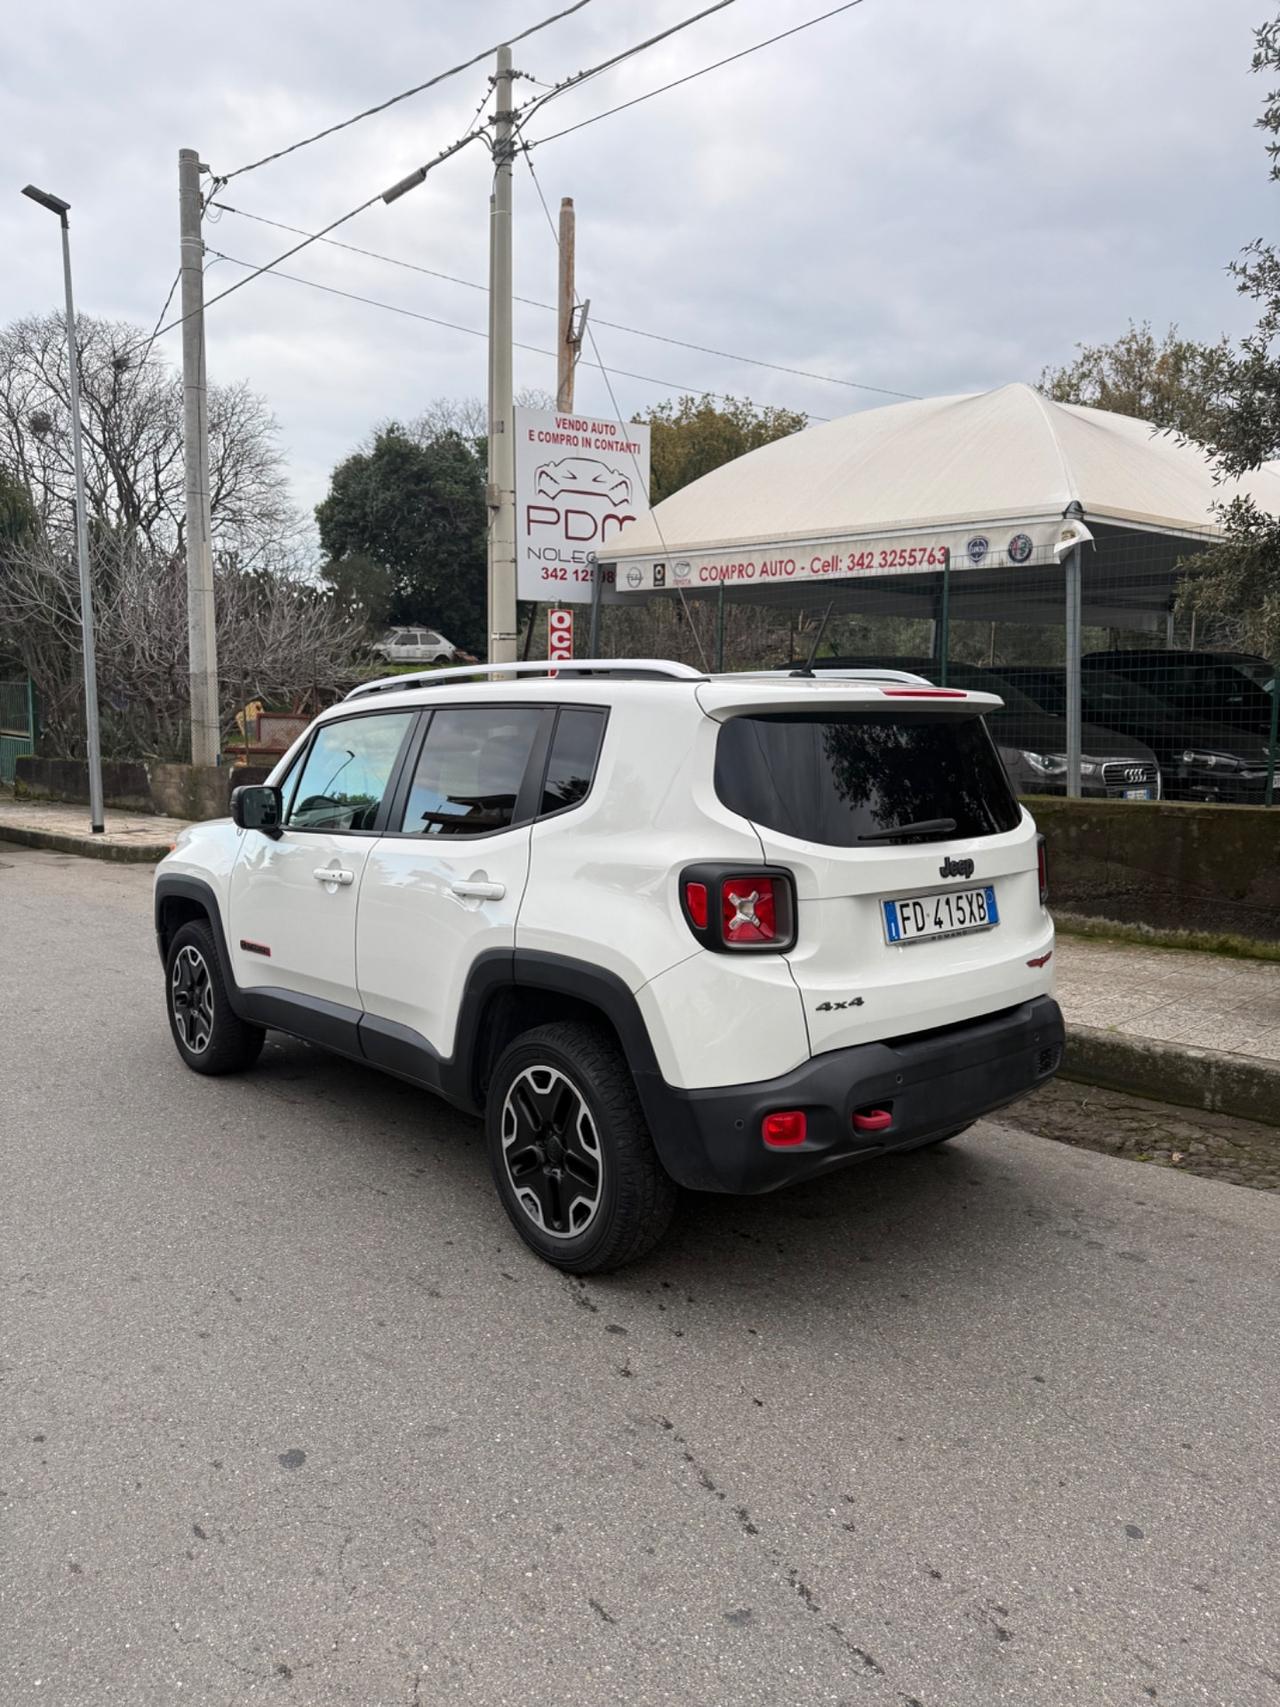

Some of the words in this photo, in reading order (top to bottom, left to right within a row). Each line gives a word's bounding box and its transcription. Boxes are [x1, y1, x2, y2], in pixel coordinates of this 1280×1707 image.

[555, 417, 588, 432] VENDO
[591, 422, 616, 436] AUTO
[528, 430, 535, 441] E
[538, 431, 579, 447] COMPRO
[582, 437, 591, 449] IN
[594, 438, 640, 454] CONTANTI
[541, 567, 567, 581] 342
[699, 562, 755, 582] COMPRO
[760, 559, 796, 577] AUTO
[810, 555, 842, 574] Cell:
[847, 552, 874, 571] 342
[878, 546, 947, 568] 3255763
[940, 857, 975, 879] Jeep
[900, 901, 926, 935] FD
[933, 892, 987, 929] 415XB
[815, 997, 865, 1011] 4x4
